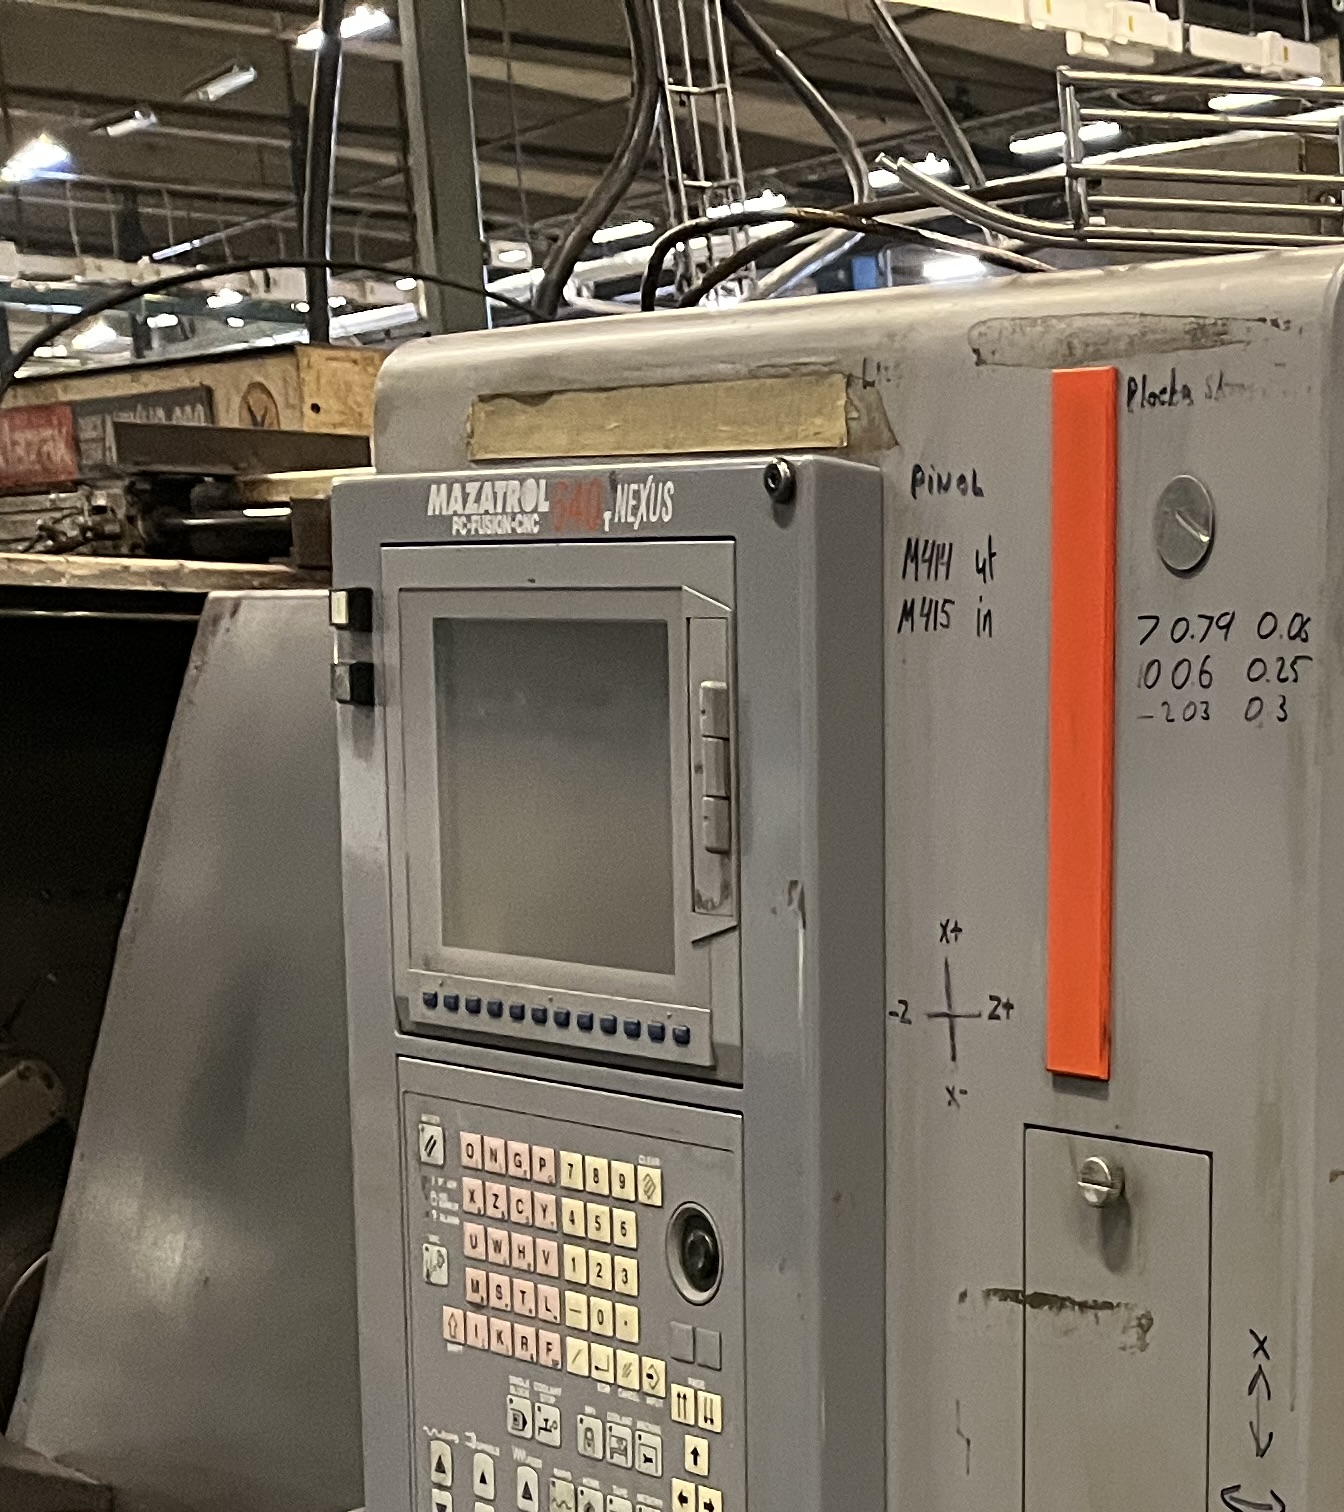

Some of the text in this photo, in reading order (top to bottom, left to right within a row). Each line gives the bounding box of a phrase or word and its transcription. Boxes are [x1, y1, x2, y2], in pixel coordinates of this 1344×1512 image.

[427, 478, 549, 516] MAZATROL
[614, 475, 675, 530] NEXUS
[902, 537, 953, 582] M414
[897, 595, 992, 637] M415 in
